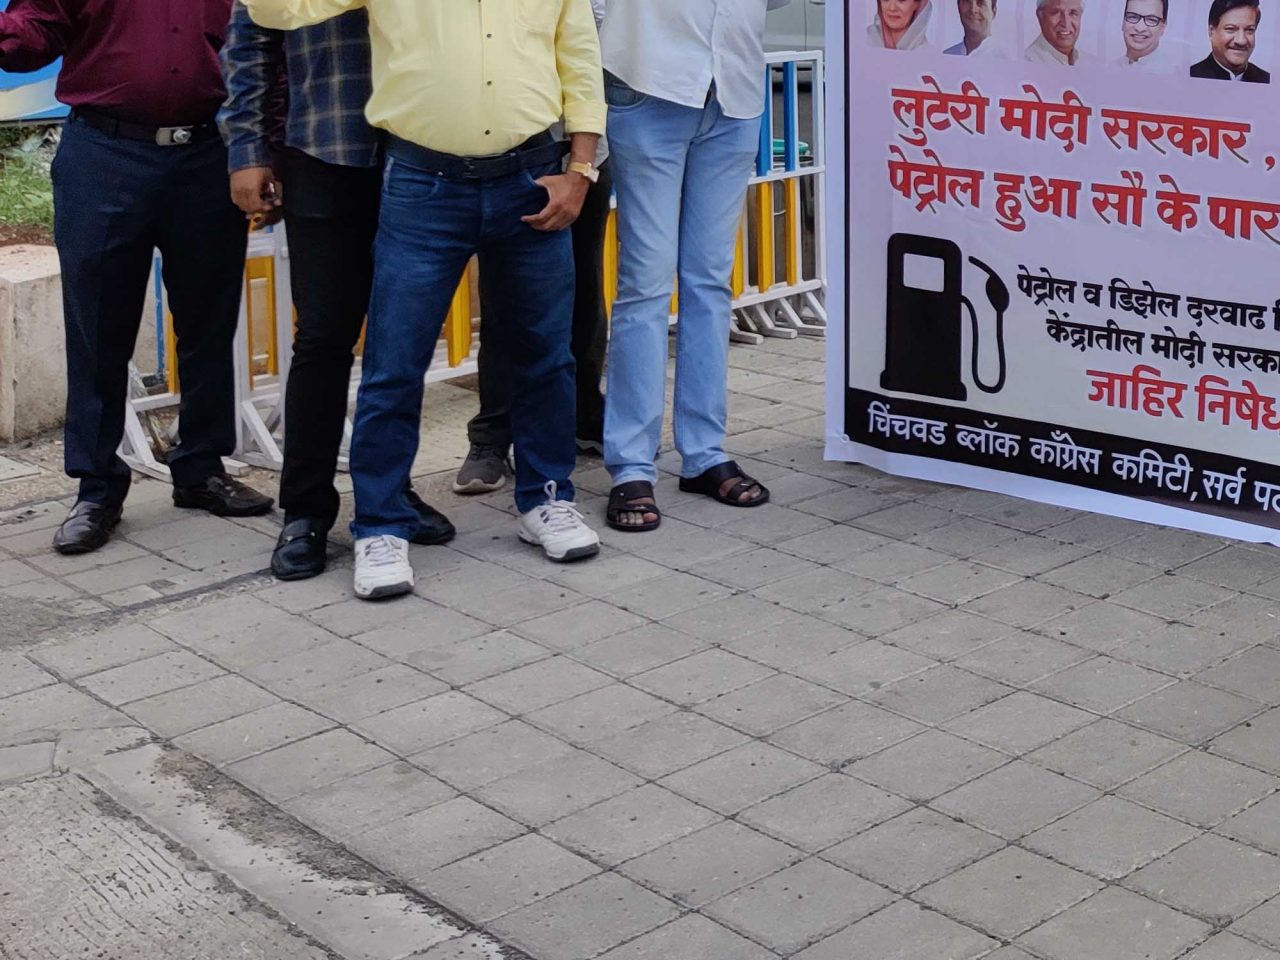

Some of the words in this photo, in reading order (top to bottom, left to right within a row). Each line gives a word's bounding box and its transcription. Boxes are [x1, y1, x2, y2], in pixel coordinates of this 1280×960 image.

[891, 75, 990, 147] लुटेरी
[999, 84, 1092, 153] मोदी
[888, 144, 985, 214] पेट्रोल
[993, 172, 1082, 232] हुआ
[1091, 170, 1147, 228] सौ
[1155, 174, 1201, 233] के
[1016, 264, 1077, 307] पेट्रोल
[1082, 282, 1103, 307] व
[1108, 277, 1181, 319] डिझेल
[1186, 296, 1267, 328] दरवाढ
[1046, 309, 1145, 356] केंद्रातील
[1151, 326, 1206, 369] मोदी
[1086, 364, 1188, 419] जाहिर
[867, 400, 948, 446] चिंचवड
[955, 419, 1021, 458] ब्लॉक
